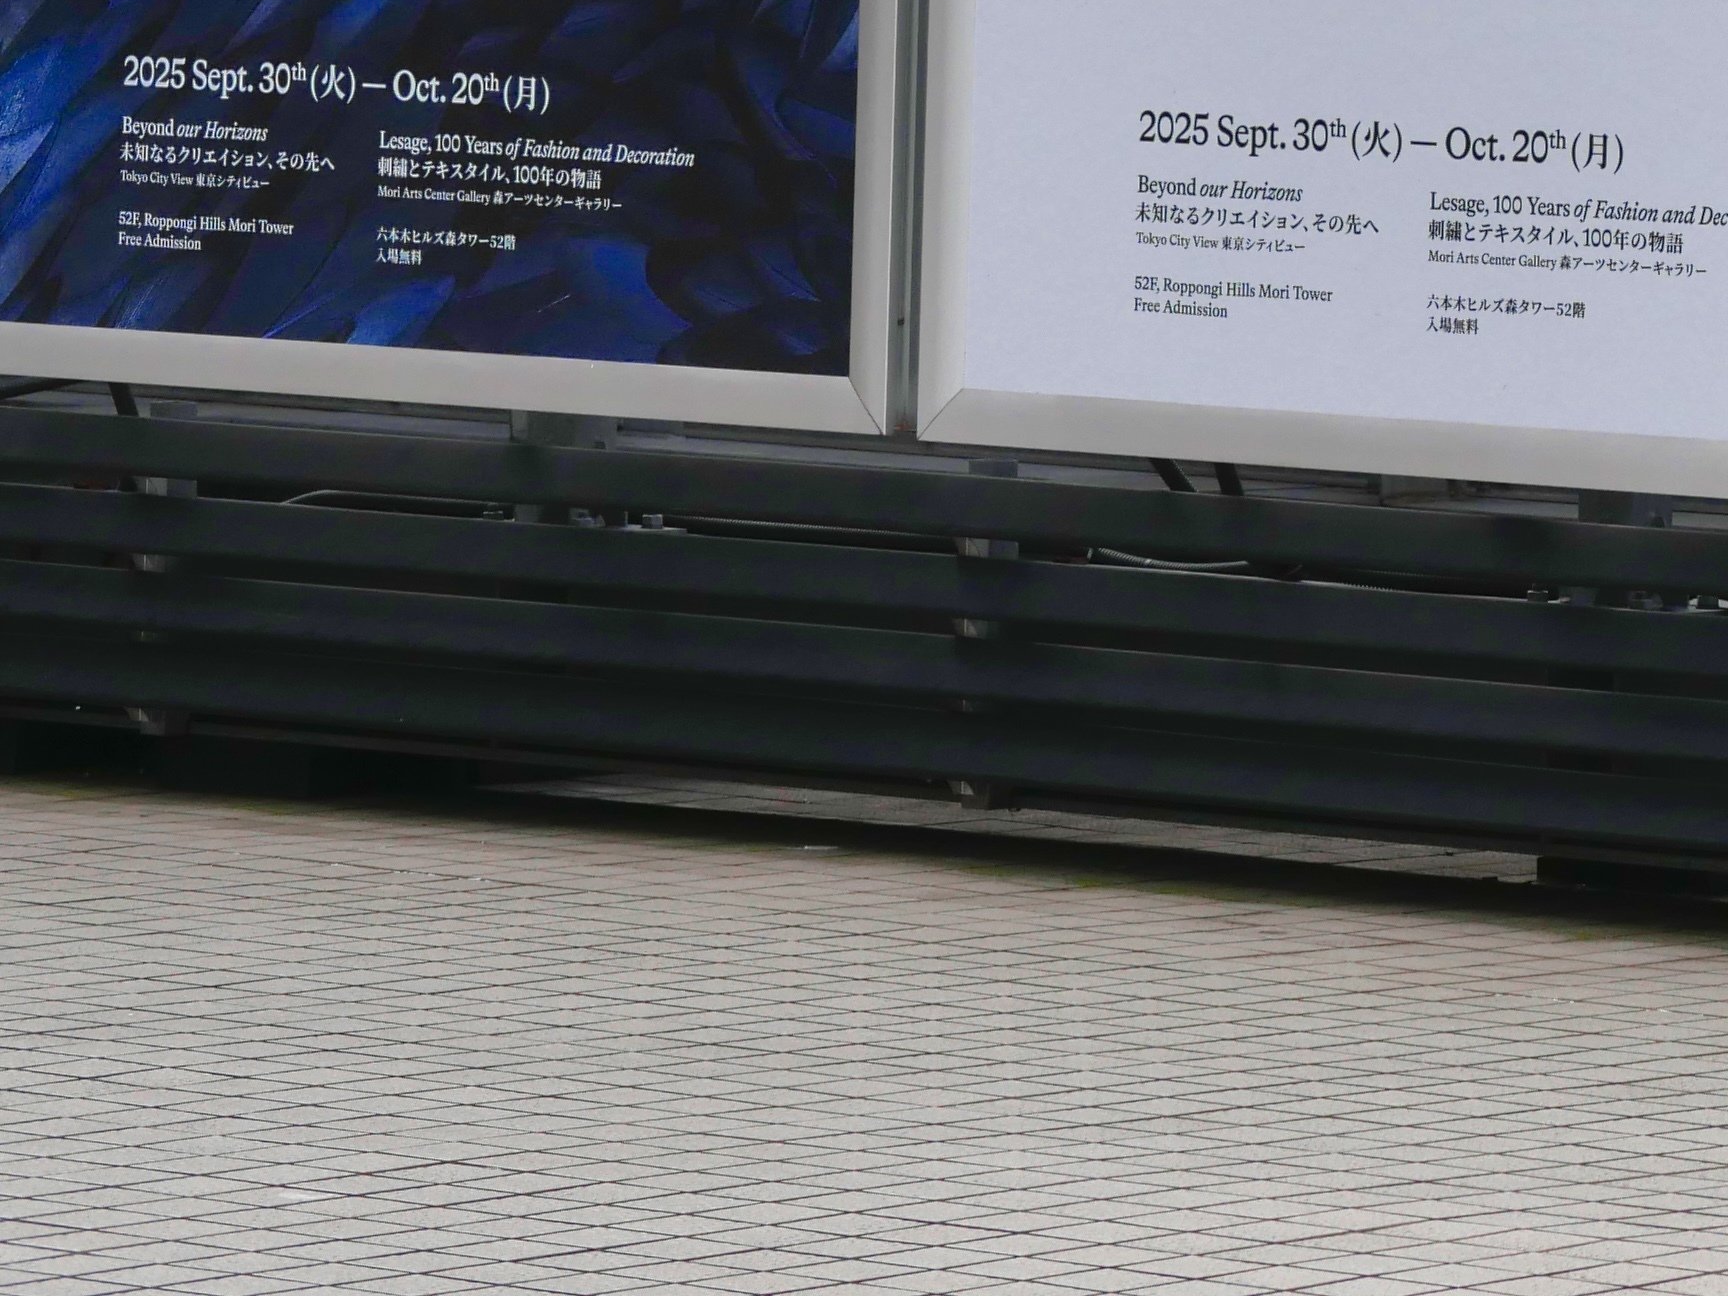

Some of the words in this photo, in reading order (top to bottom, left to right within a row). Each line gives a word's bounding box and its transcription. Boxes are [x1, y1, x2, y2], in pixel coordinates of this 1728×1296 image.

[122, 115, 175, 139] Beyond
[176, 124, 202, 138] our
[203, 121, 269, 142] Horizons
[1139, 109, 1209, 146] 2025
[1216, 114, 1286, 158] Sept.
[1445, 126, 1506, 162] Oct.
[379, 131, 432, 156] Lesage,
[434, 133, 461, 153] 100
[464, 134, 503, 156] Years
[505, 137, 522, 160] of
[522, 138, 580, 160] Fashion
[582, 143, 613, 162] and
[614, 144, 695, 166] Decoration
[1138, 174, 1197, 199] Beyond
[1199, 183, 1228, 198] our
[1230, 180, 1304, 203] Horizons
[1136, 201, 1379, 236] 未知なるクリエイション、その先へ
[1430, 191, 1490, 218] Lesage,
[1492, 194, 1523, 215] 100
[1527, 195, 1571, 218] Years
[1573, 198, 1593, 223] of
[1592, 199, 1659, 223] Fashion
[1661, 205, 1696, 225] and
[1428, 219, 1684, 254] 刺繍とテキスタイル、100年の物語
[1427, 294, 1586, 319] 六本木ヒルズ森タワー52階
[1427, 317, 1479, 336] 入場無料
